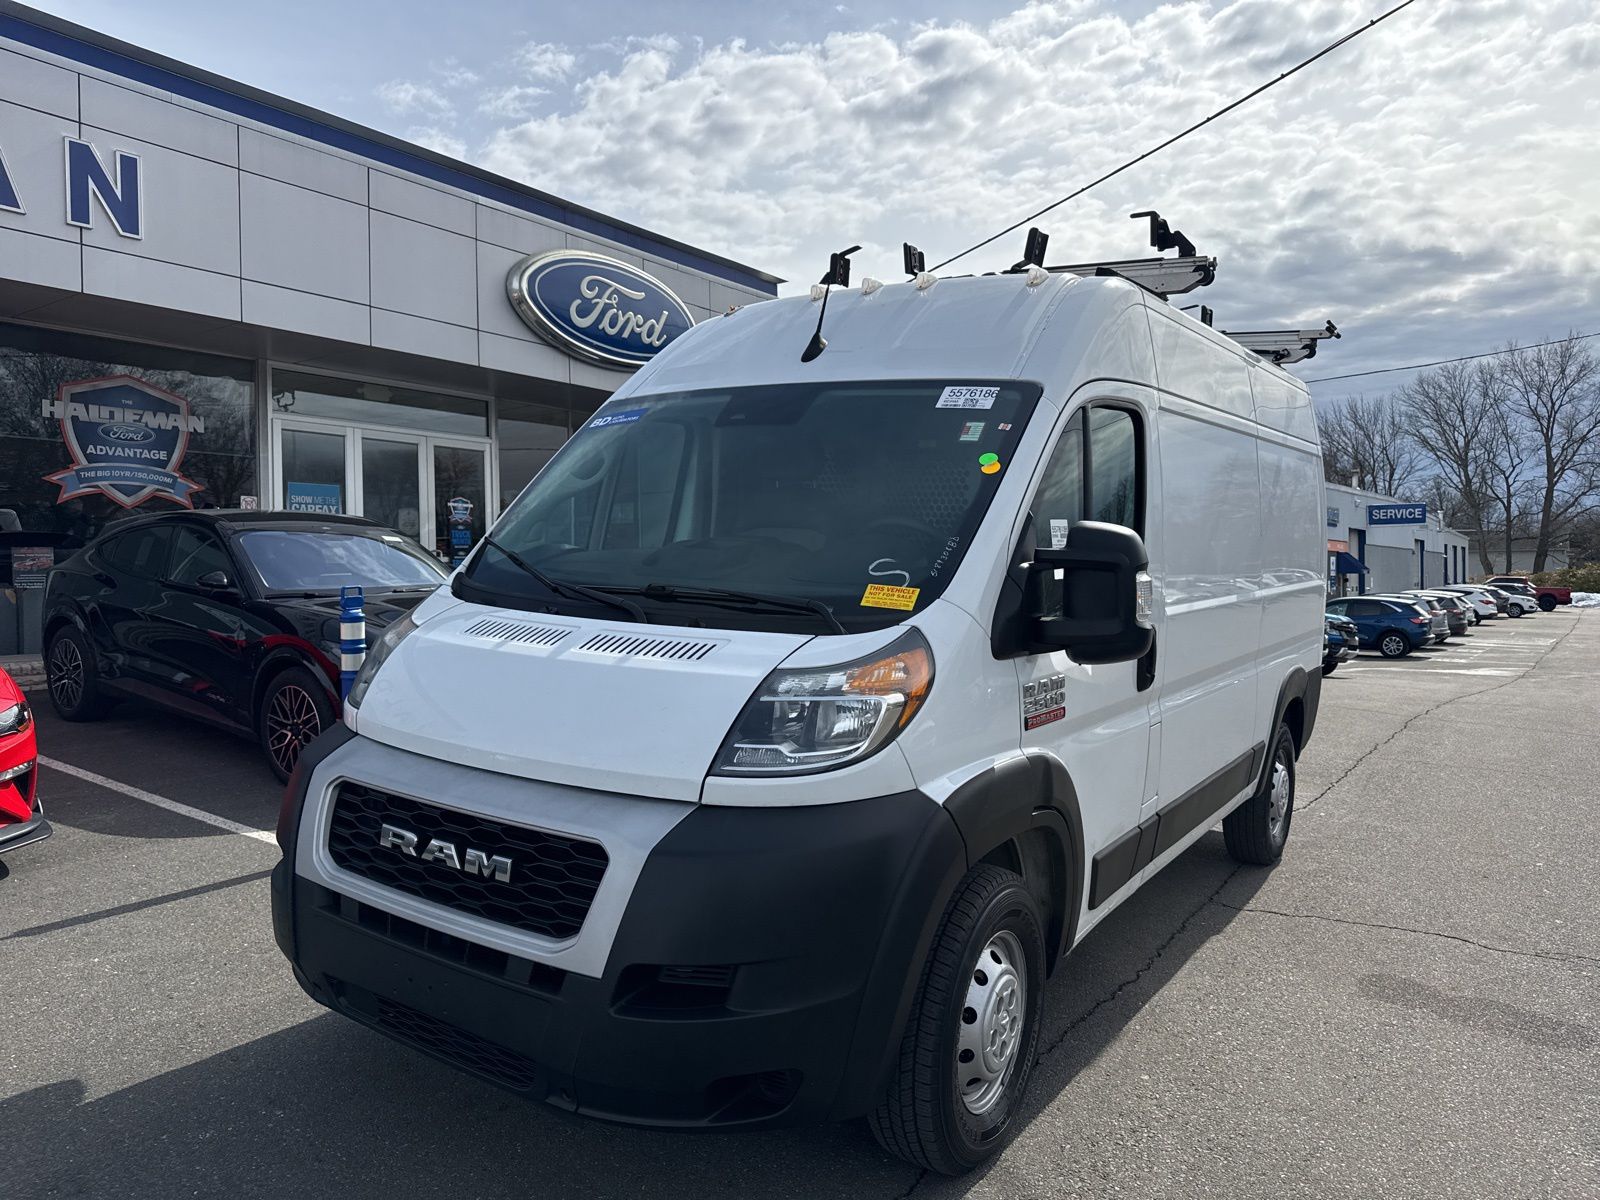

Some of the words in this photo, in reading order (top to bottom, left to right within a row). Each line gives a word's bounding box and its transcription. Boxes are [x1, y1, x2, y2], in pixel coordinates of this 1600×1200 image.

[569, 275, 669, 347] Ford
[948, 388, 999, 398] 5576186
[42, 399, 205, 433] HALDEMAN
[589, 416, 612, 428] BD
[109, 425, 145, 441] Ford
[86, 444, 168, 461] ADVANTAGE
[80, 470, 96, 479] THE
[291, 495, 313, 503] SHOW
[1372, 508, 1423, 519] SERVICE
[886, 587, 917, 595] VEHICLE
[1023, 674, 1065, 699] RAM
[380, 823, 513, 883] RAM
